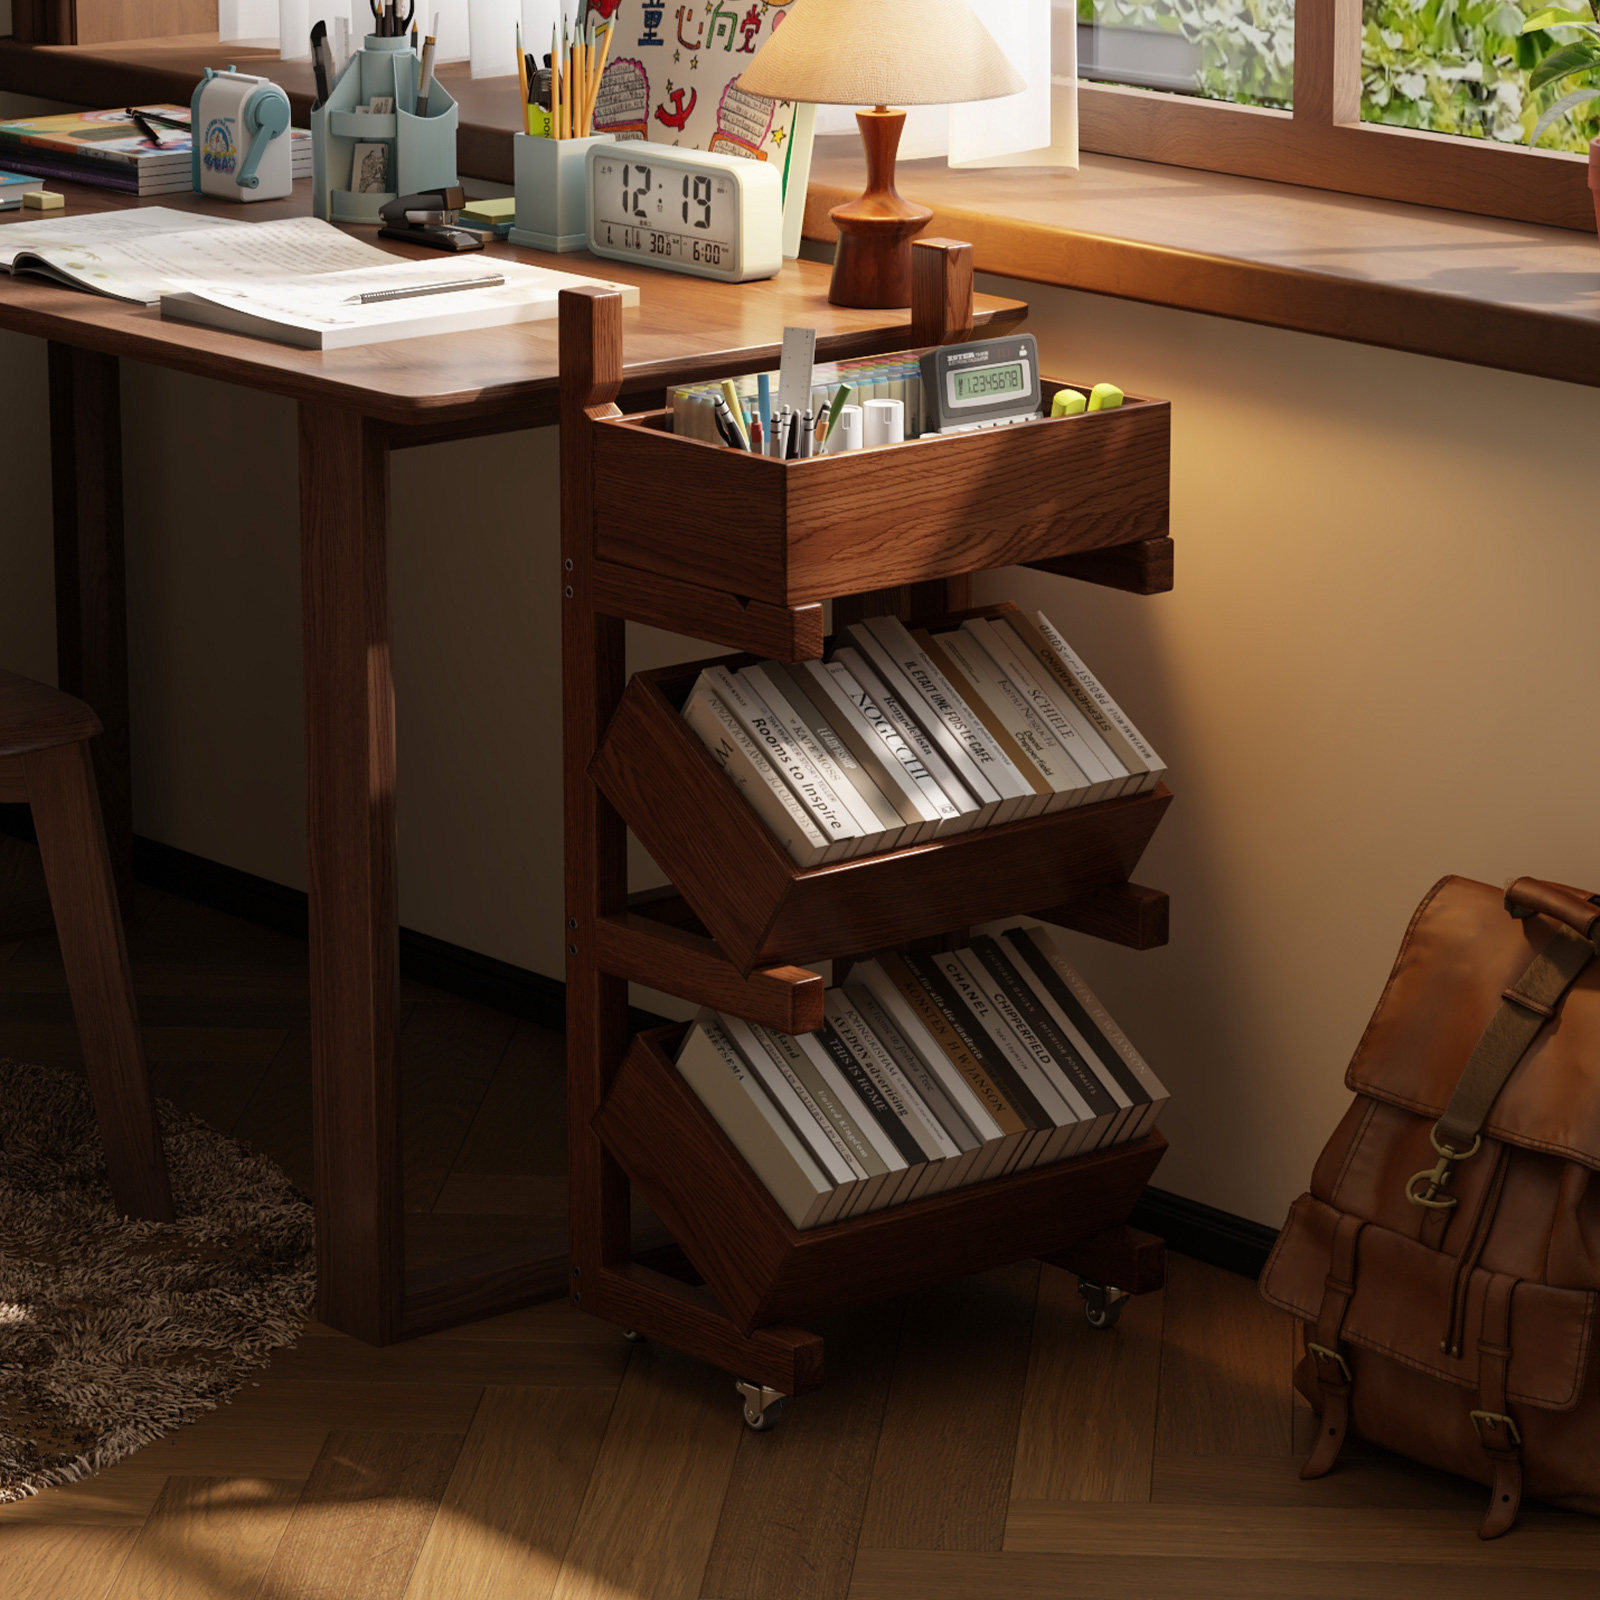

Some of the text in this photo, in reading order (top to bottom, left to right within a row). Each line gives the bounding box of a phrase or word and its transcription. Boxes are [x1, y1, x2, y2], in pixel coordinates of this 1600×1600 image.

[622, 164, 712, 230] 12:19
[692, 241, 721, 265] 6:00
[1037, 624, 1067, 651] SQUID
[903, 661, 920, 671] IL
[929, 692, 952, 710] UNE
[959, 730, 977, 742] LE
[1037, 648, 1112, 731] STEPHEN MARINO
[1074, 669, 1109, 704] PROUST
[707, 698, 753, 747] MOUNTAIN
[850, 692, 931, 781] NOGUCHI
[1022, 730, 1045, 750] David
[1026, 688, 1076, 740] SCHIELE
[750, 718, 846, 830] Rooms to Inspire
[791, 726, 840, 779] KATE MOSS
[900, 982, 952, 1035] KONSTEN
[943, 965, 993, 1017] CHANEL
[991, 994, 1055, 1064] CHIPPERFIELD
[827, 1040, 854, 1064] THIS
[854, 1079, 891, 1113] HOME
[829, 1015, 913, 1116] AVEDON advertising
[815, 1091, 846, 1120] United
